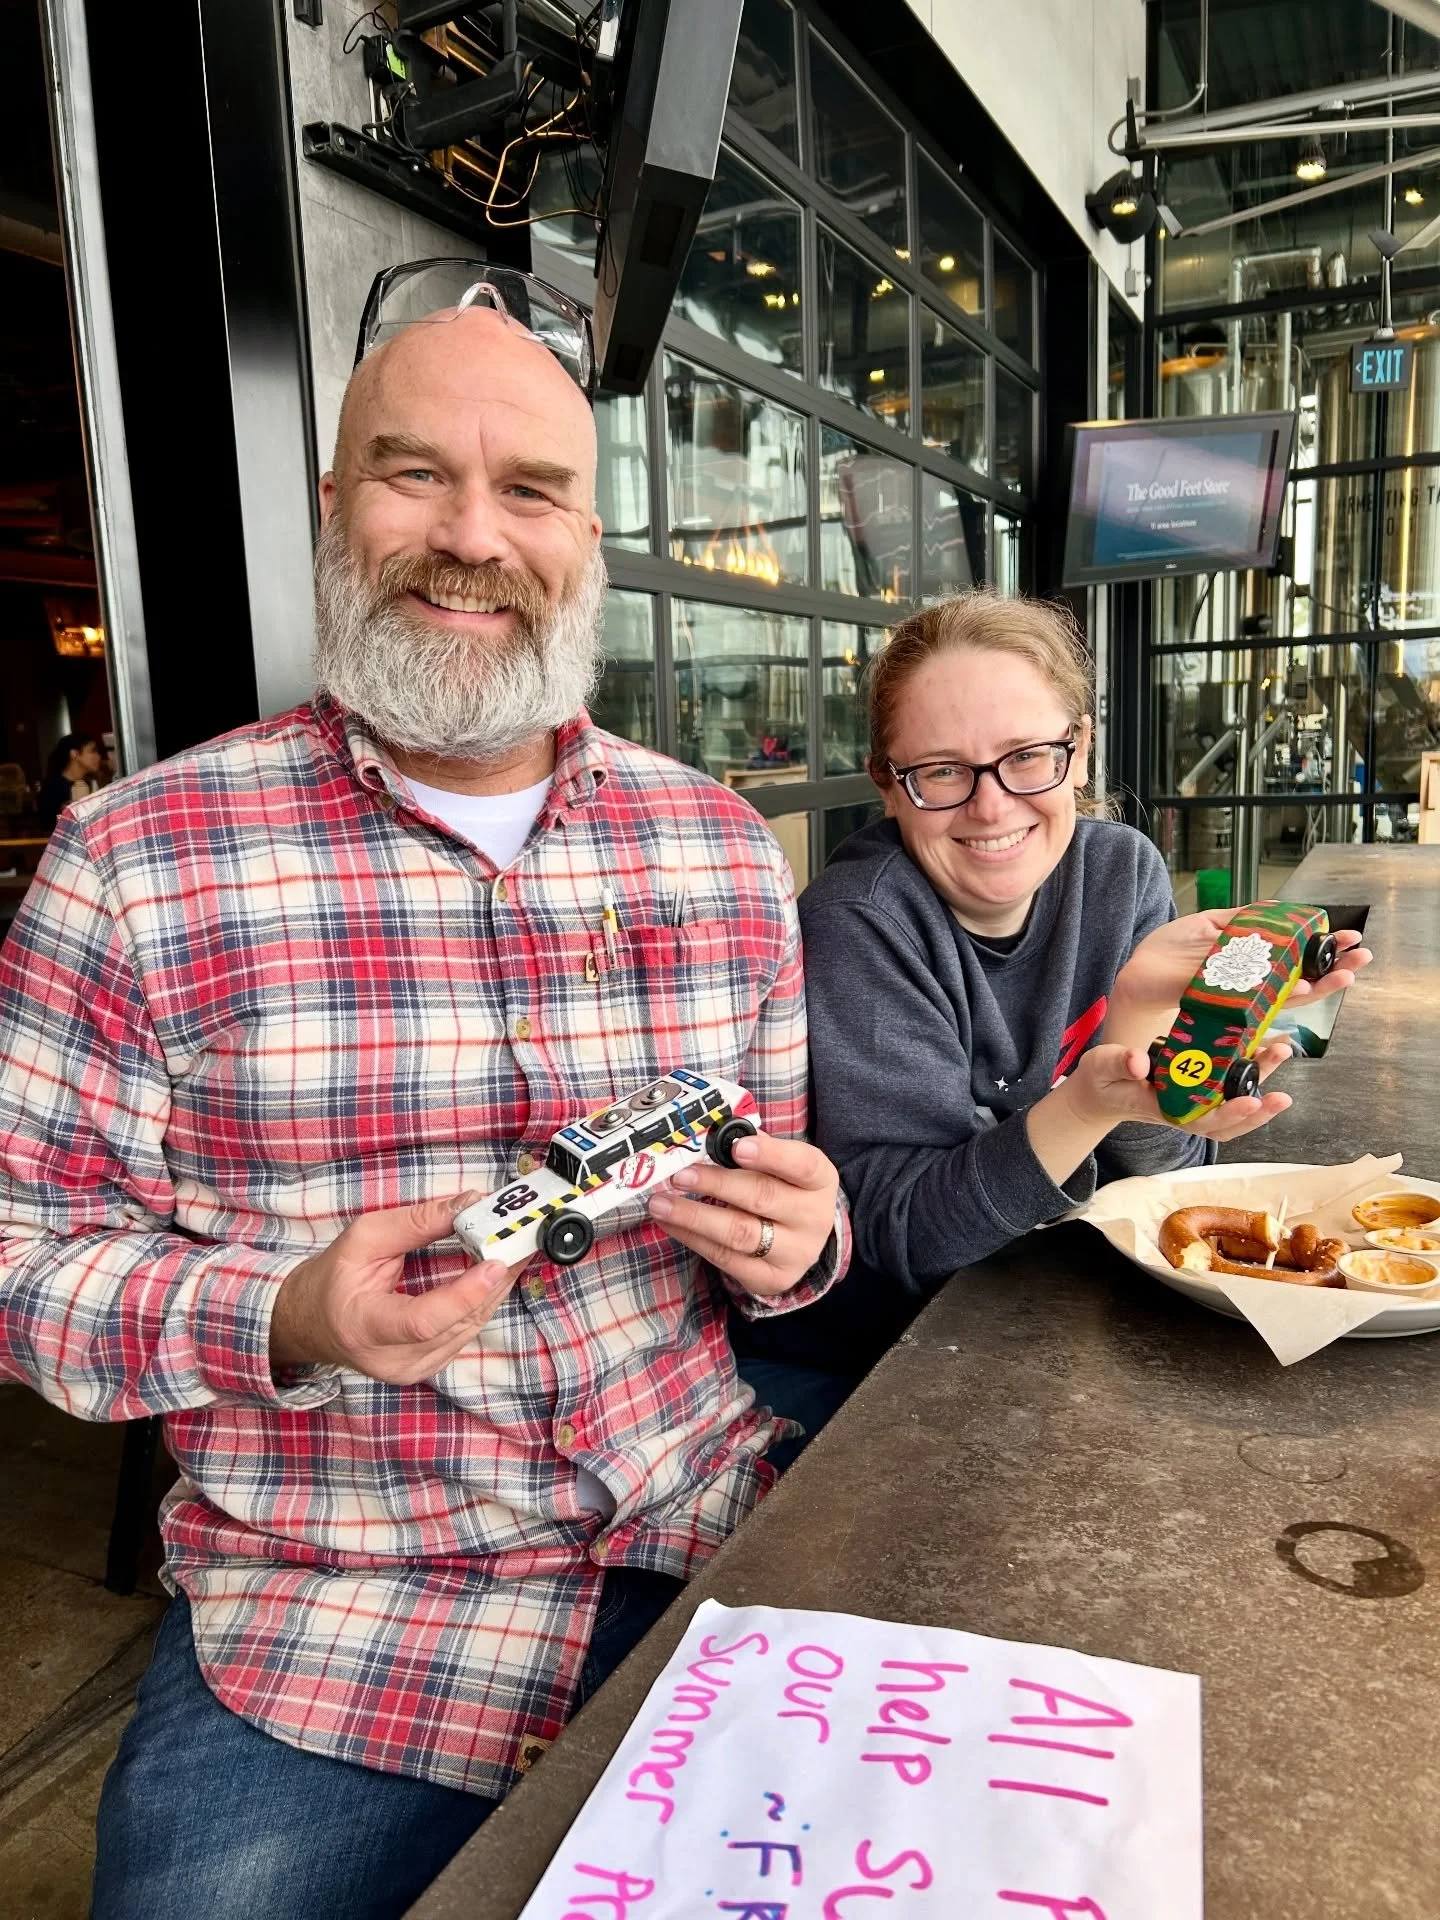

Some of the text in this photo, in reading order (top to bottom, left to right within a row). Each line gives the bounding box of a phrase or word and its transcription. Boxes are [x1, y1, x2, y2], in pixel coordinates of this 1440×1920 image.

[1362, 348, 1404, 386] EXIT
[1126, 477, 1230, 501] The Good Feet Store
[1175, 1058, 1206, 1080] 42
[625, 1632, 770, 1826] Summer
[860, 1660, 969, 1786] help
[987, 1677, 1134, 1806] All
